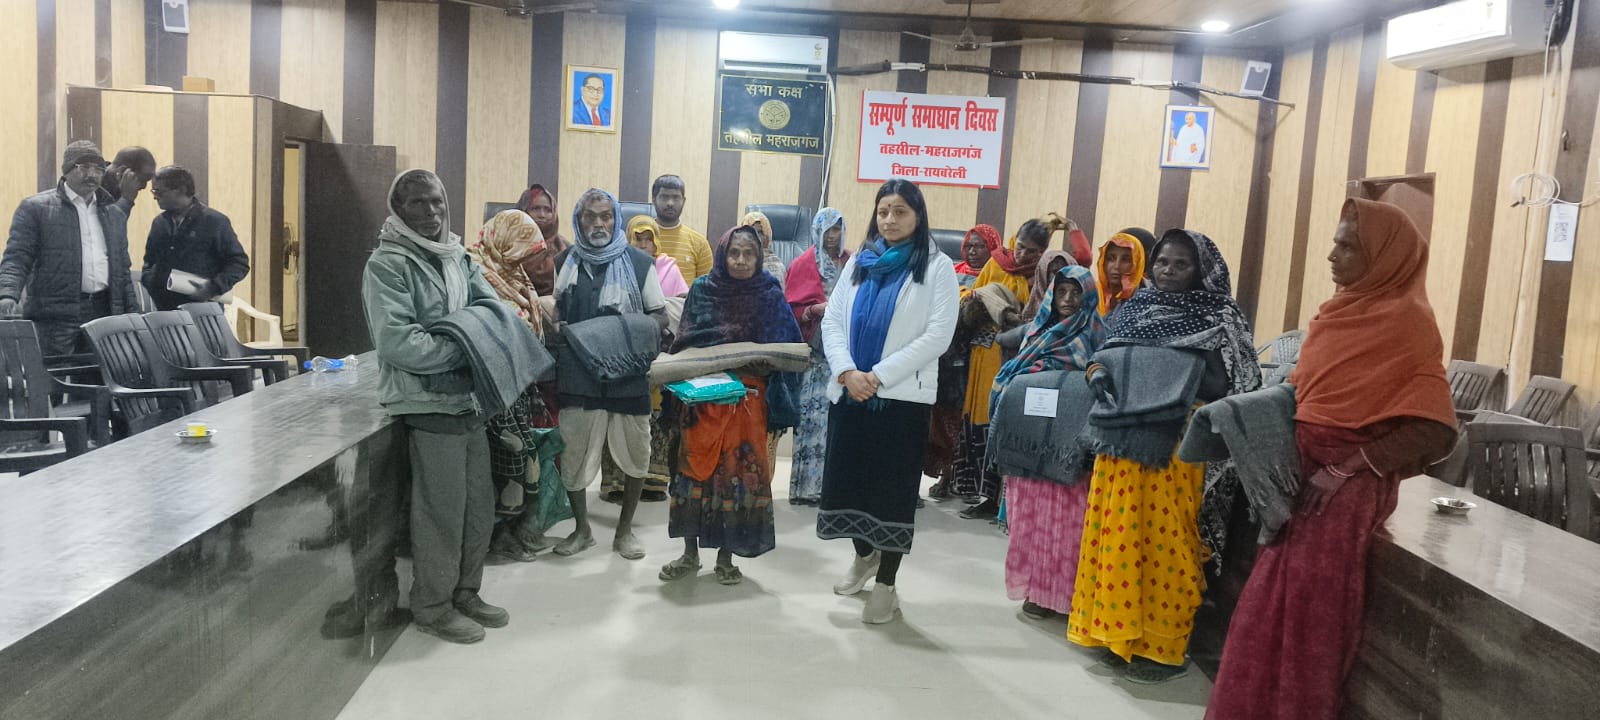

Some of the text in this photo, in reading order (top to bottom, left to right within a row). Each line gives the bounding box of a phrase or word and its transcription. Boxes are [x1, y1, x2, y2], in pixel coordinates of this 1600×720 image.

[744, 83, 803, 98] सभा कक्ष
[869, 97, 908, 136] सम्पूर्ण
[965, 101, 999, 132] दिवस
[766, 133, 820, 149] महराजगंज
